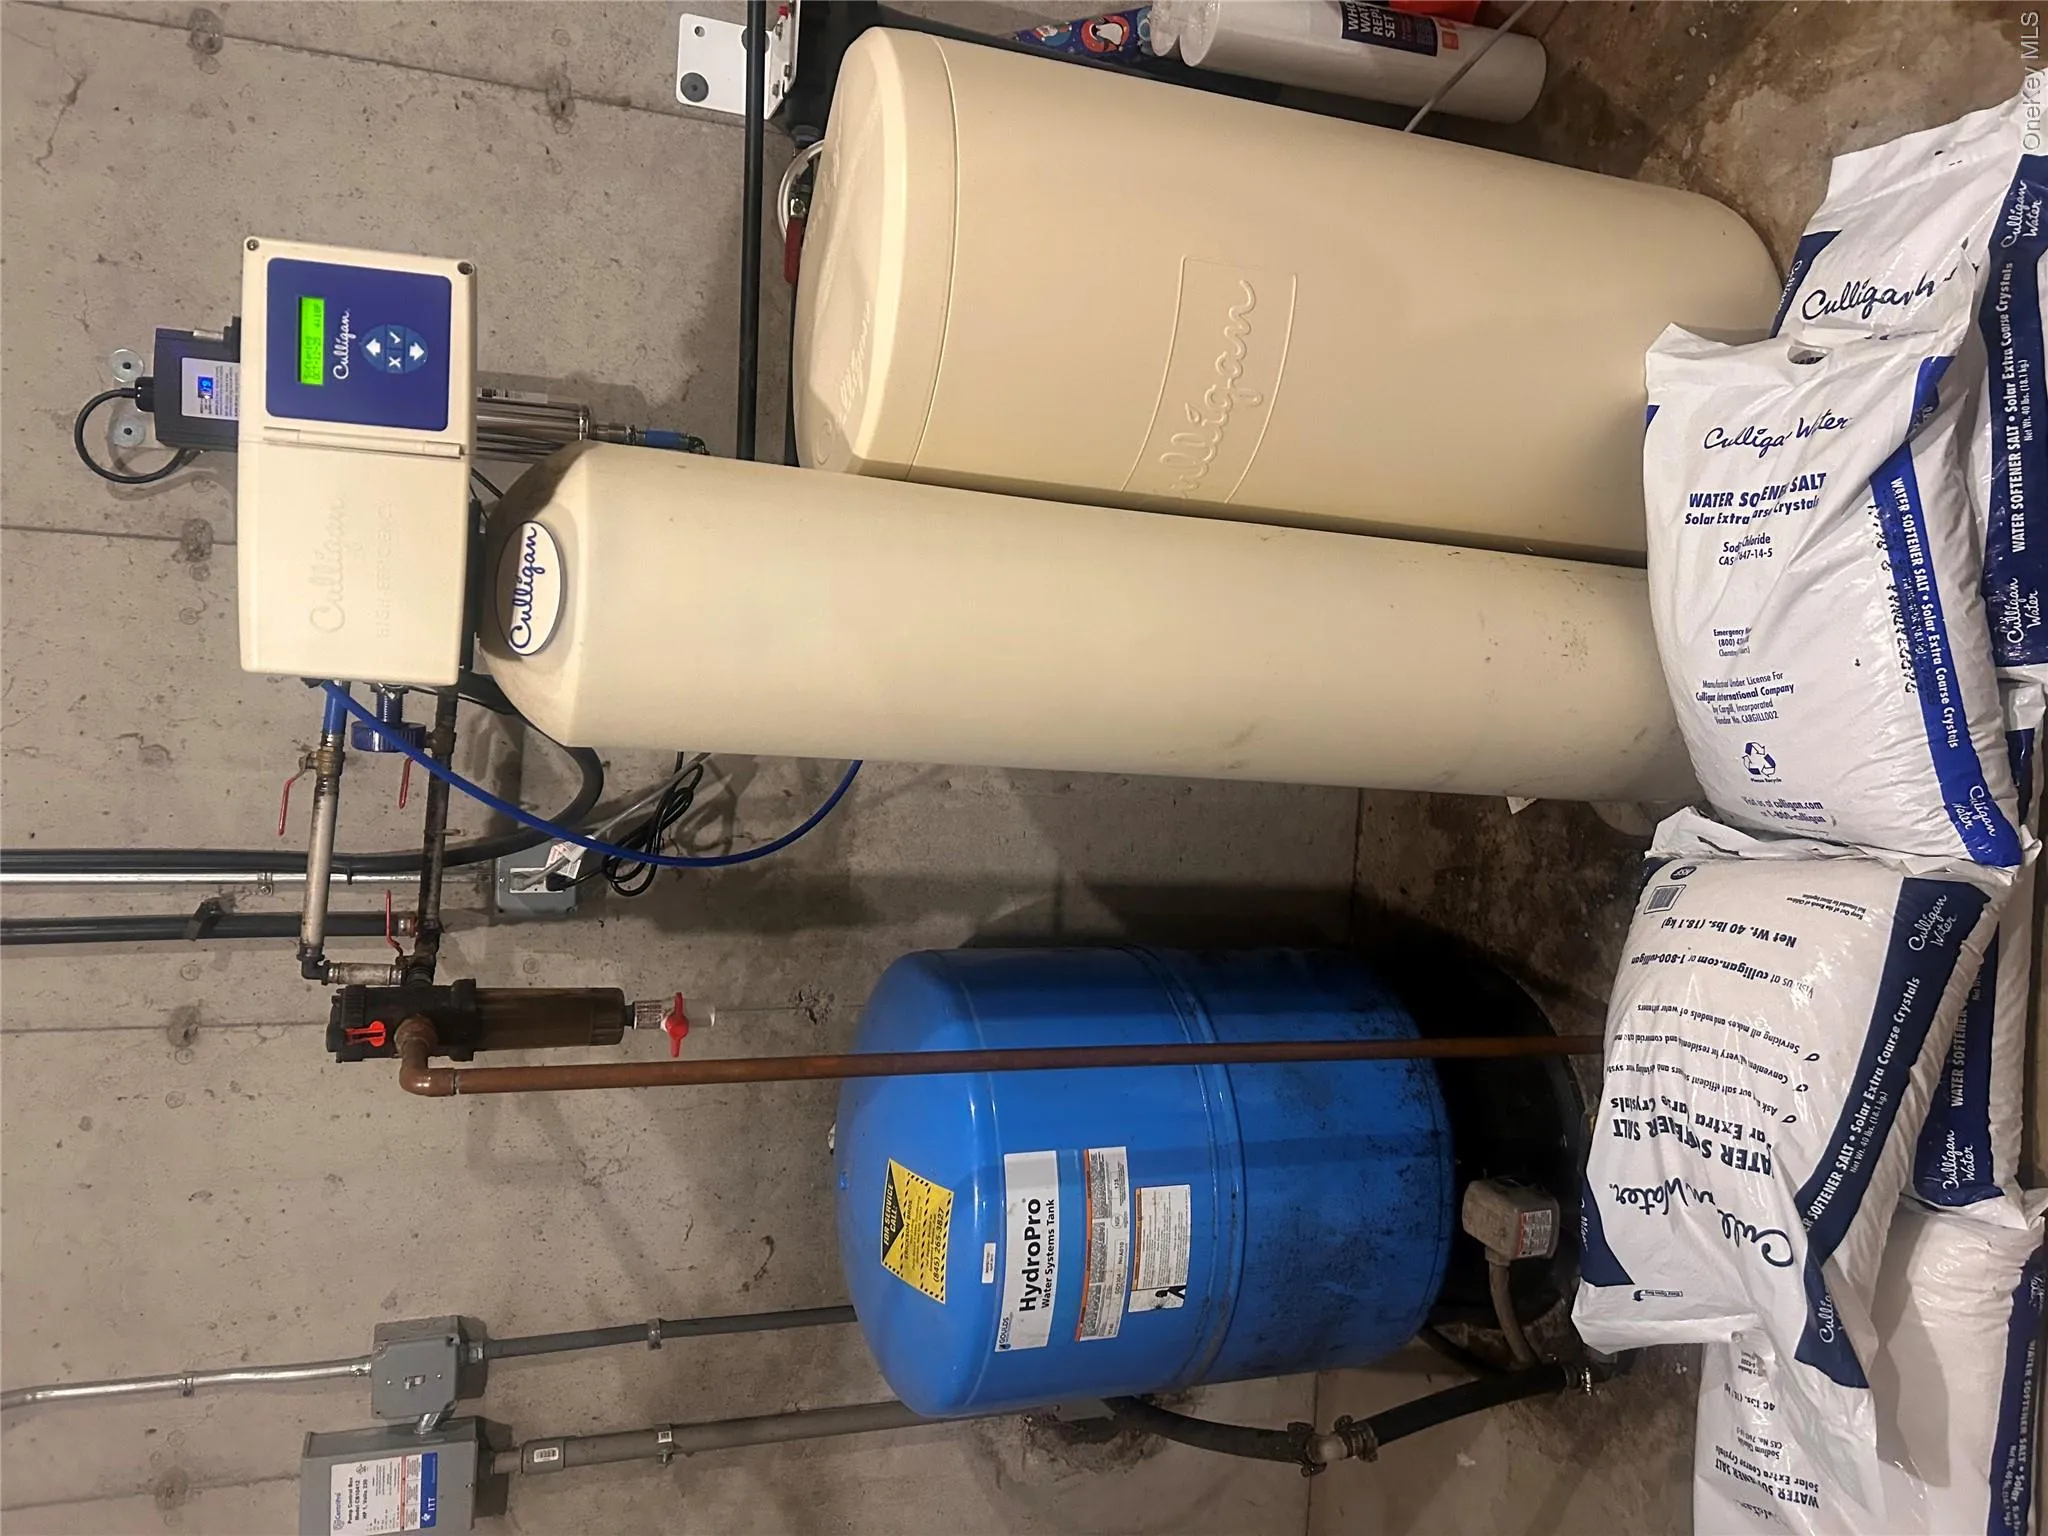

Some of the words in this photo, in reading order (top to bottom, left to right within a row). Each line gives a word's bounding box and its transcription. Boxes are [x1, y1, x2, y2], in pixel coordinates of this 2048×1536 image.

[1384, 13, 1396, 39] SET
[1999, 180, 2028, 249] Culligan
[2023, 199, 2043, 238] Water
[1995, 262, 2014, 312] Crystals
[332, 310, 357, 380] Culligan
[2001, 347, 2016, 380] Extra
[1158, 278, 1264, 500] ulligan
[2003, 382, 2018, 413] Solar
[2021, 405, 2031, 415] 40
[1703, 425, 1793, 458] Culliga
[1795, 408, 1853, 440] Wter
[2007, 424, 2021, 451] SALT
[2023, 429, 2033, 442] Net
[1688, 491, 1734, 509] WATER
[1788, 472, 1827, 493] SALT
[2008, 451, 2024, 511] SOFTENER
[1890, 477, 1910, 513] WATER
[1684, 512, 1715, 526] Solar
[1716, 512, 1750, 526] Extra
[1901, 513, 1925, 567] SOFTENER
[2012, 512, 2026, 553] WATER
[1718, 556, 1735, 568] CAS
[508, 526, 546, 650] Culligan
[1913, 566, 1930, 595] SALT
[1921, 603, 1936, 637] Solar
[2006, 577, 2025, 644] Culligan
[2022, 590, 2042, 630] Water
[1713, 629, 1745, 637] Emergency
[1718, 638, 1735, 648] (800)
[1928, 633, 1943, 666] Extra
[1746, 674, 1772, 686] License
[1771, 671, 1784, 681] For
[1760, 683, 1795, 697] Company
[1935, 666, 1951, 706] Course
[1735, 698, 1774, 713] Incorporated
[1741, 710, 1779, 724] CARGILL002
[1942, 706, 1959, 750] Crystals
[1773, 798, 1824, 812] culligan.com
[1660, 916, 1678, 930] kg)
[1679, 917, 1706, 930] (18.1
[1709, 919, 1728, 931] lbs.
[1729, 922, 1747, 935] 40
[1750, 925, 1771, 942] Wt.
[1908, 894, 1947, 952] Culligan
[1772, 931, 1798, 949] Net
[1631, 953, 1686, 965] 1-800-culligan
[1687, 954, 1697, 962] or
[1696, 954, 1769, 980] culligan.com
[1770, 973, 1781, 983] at
[1782, 977, 1794, 988] us
[1678, 1007, 1688, 1017] of
[1713, 1016, 1726, 1026] and
[1750, 1027, 1761, 1038] all
[1762, 1029, 1801, 1054] Servicing
[1691, 1076, 1721, 1093] efficient
[1721, 1085, 1738, 1096] salt
[1738, 1089, 1752, 1098] our
[1812, 1170, 1844, 1219] SOFTENER
[1835, 1141, 1855, 1172] SALT
[1849, 1102, 1871, 1134] Solar
[1863, 1064, 1884, 1102] Extra
[1877, 1026, 1900, 1065] Course
[1898, 975, 1921, 1024] Crystals
[1951, 1069, 1964, 1107] WATER
[1610, 1095, 1656, 1113] Crystals
[1761, 1102, 1778, 1116] Ask
[1694, 1113, 1743, 1141] Extra
[1720, 1143, 1774, 1178] ATER
[1849, 1160, 1860, 1174] Net
[1860, 1136, 1869, 1147] 40
[1961, 1143, 1974, 1182] Water
[884, 1182, 894, 1225] SERVICE
[1045, 1198, 1056, 1226] Tank
[883, 1225, 891, 1246] FOR
[1018, 1198, 1044, 1312] HydroPro
[1043, 1228, 1057, 1275] Systems
[932, 1256, 941, 1283] (845)
[1041, 1277, 1054, 1309] Water
[999, 1316, 1010, 1344] GOULDS
[1754, 1444, 1780, 1460] Sodium
[1769, 1439, 1783, 1450] CAS
[1715, 1457, 1732, 1475] SALT
[1763, 1471, 1791, 1485] Extra
[1793, 1478, 1819, 1493] Solar
[428, 1497, 436, 1511] ITT
[1776, 1487, 1820, 1510] WATER
